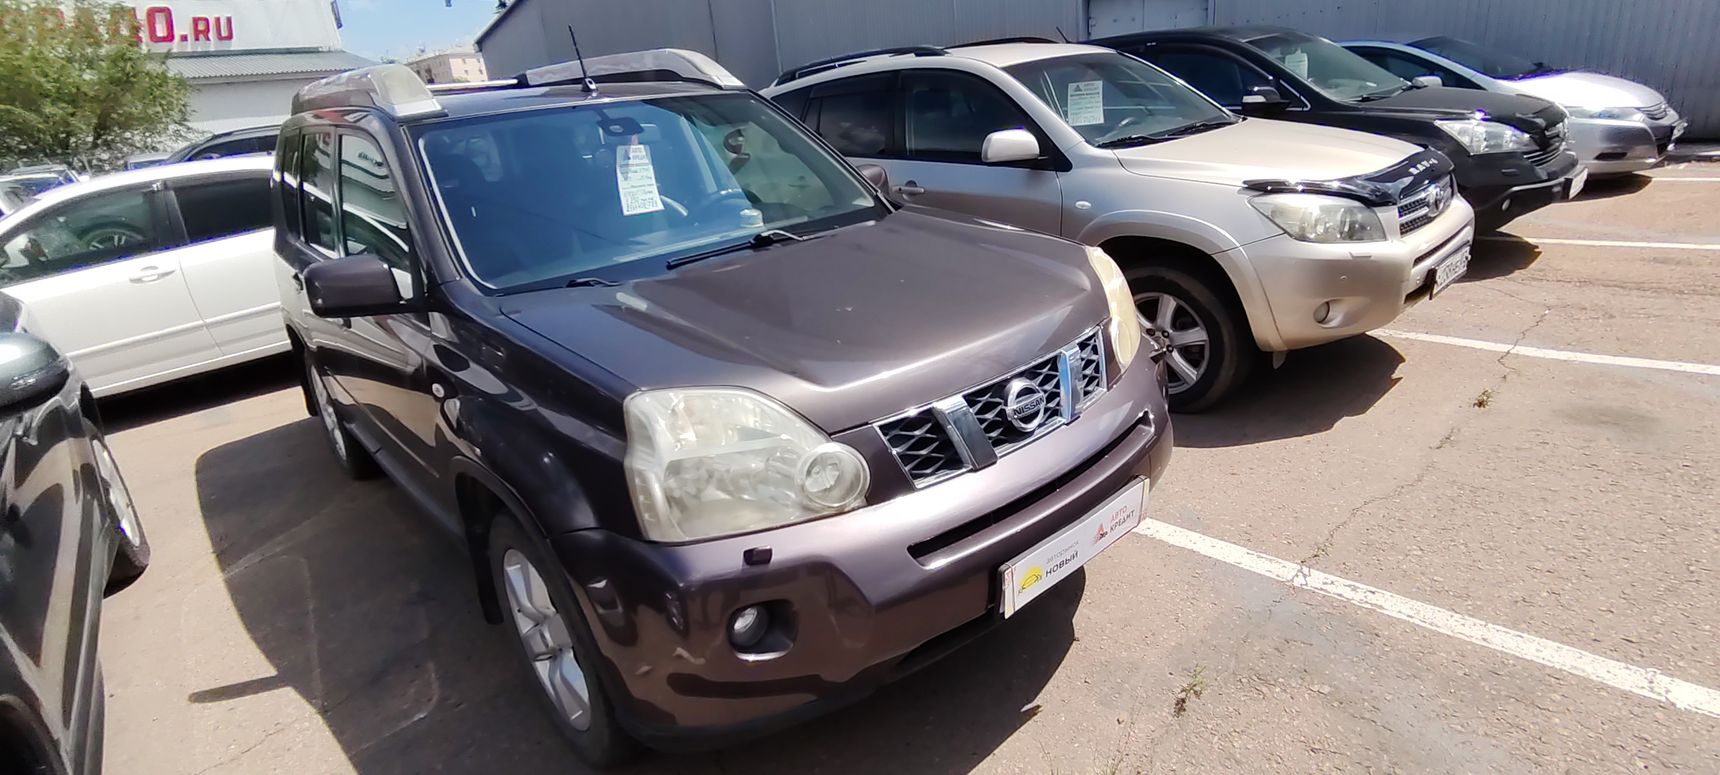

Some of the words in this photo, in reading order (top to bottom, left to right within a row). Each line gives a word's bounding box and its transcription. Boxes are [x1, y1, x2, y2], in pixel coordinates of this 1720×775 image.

[1014, 395, 1045, 416] NISSAN
[1109, 510, 1135, 533] КРЕДИТ
[1045, 550, 1079, 577] НОВЫЙ
